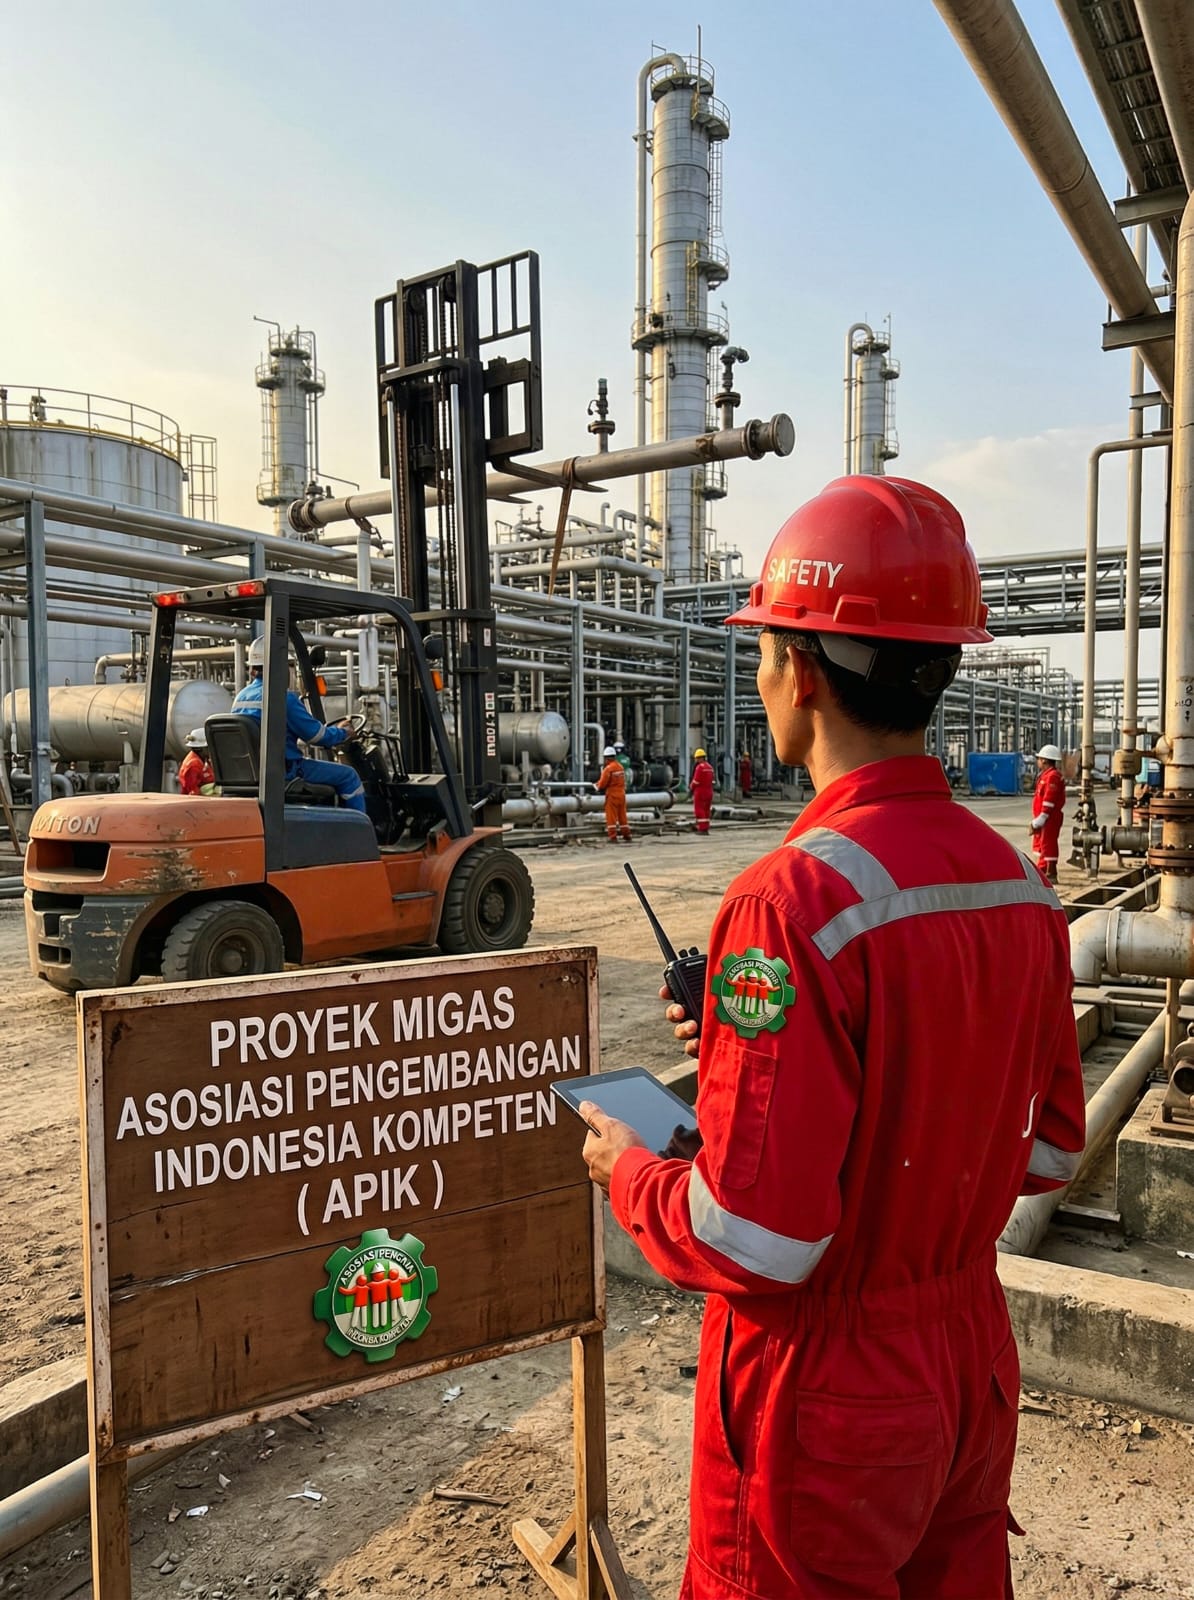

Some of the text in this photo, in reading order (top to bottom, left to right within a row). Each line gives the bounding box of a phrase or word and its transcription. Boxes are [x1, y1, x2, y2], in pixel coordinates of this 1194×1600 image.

[767, 558, 844, 588] SAFETY
[210, 986, 515, 1067] PROYEK MIGAS
[116, 1035, 581, 1140] ASOSIASI PENGEMBANGAN
[154, 1090, 557, 1193] INDONESIA KOMPETEN
